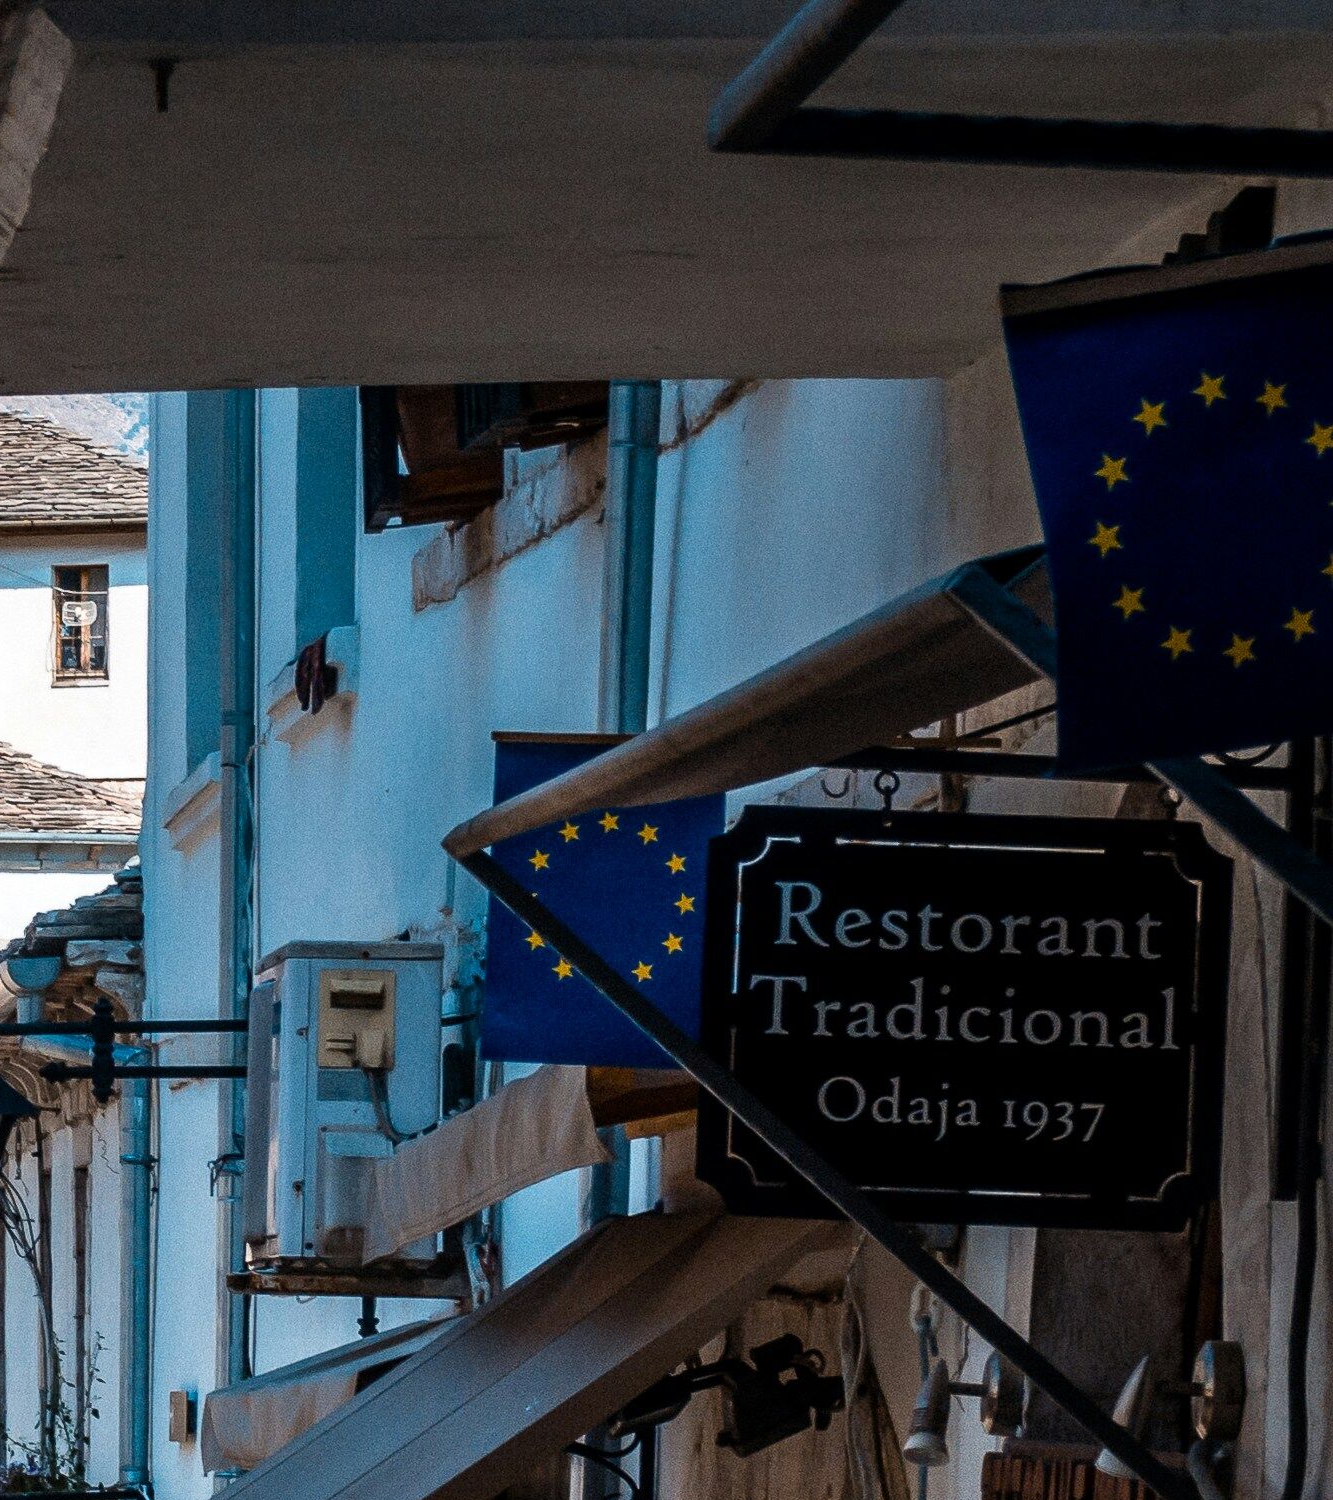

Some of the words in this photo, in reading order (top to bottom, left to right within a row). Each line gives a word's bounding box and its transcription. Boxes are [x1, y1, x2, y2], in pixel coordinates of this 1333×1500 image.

[773, 880, 1164, 961] Restorant
[749, 975, 1181, 1051] Tradicional
[817, 1076, 981, 1141] Odaja
[1003, 1098, 1105, 1143] 1937
